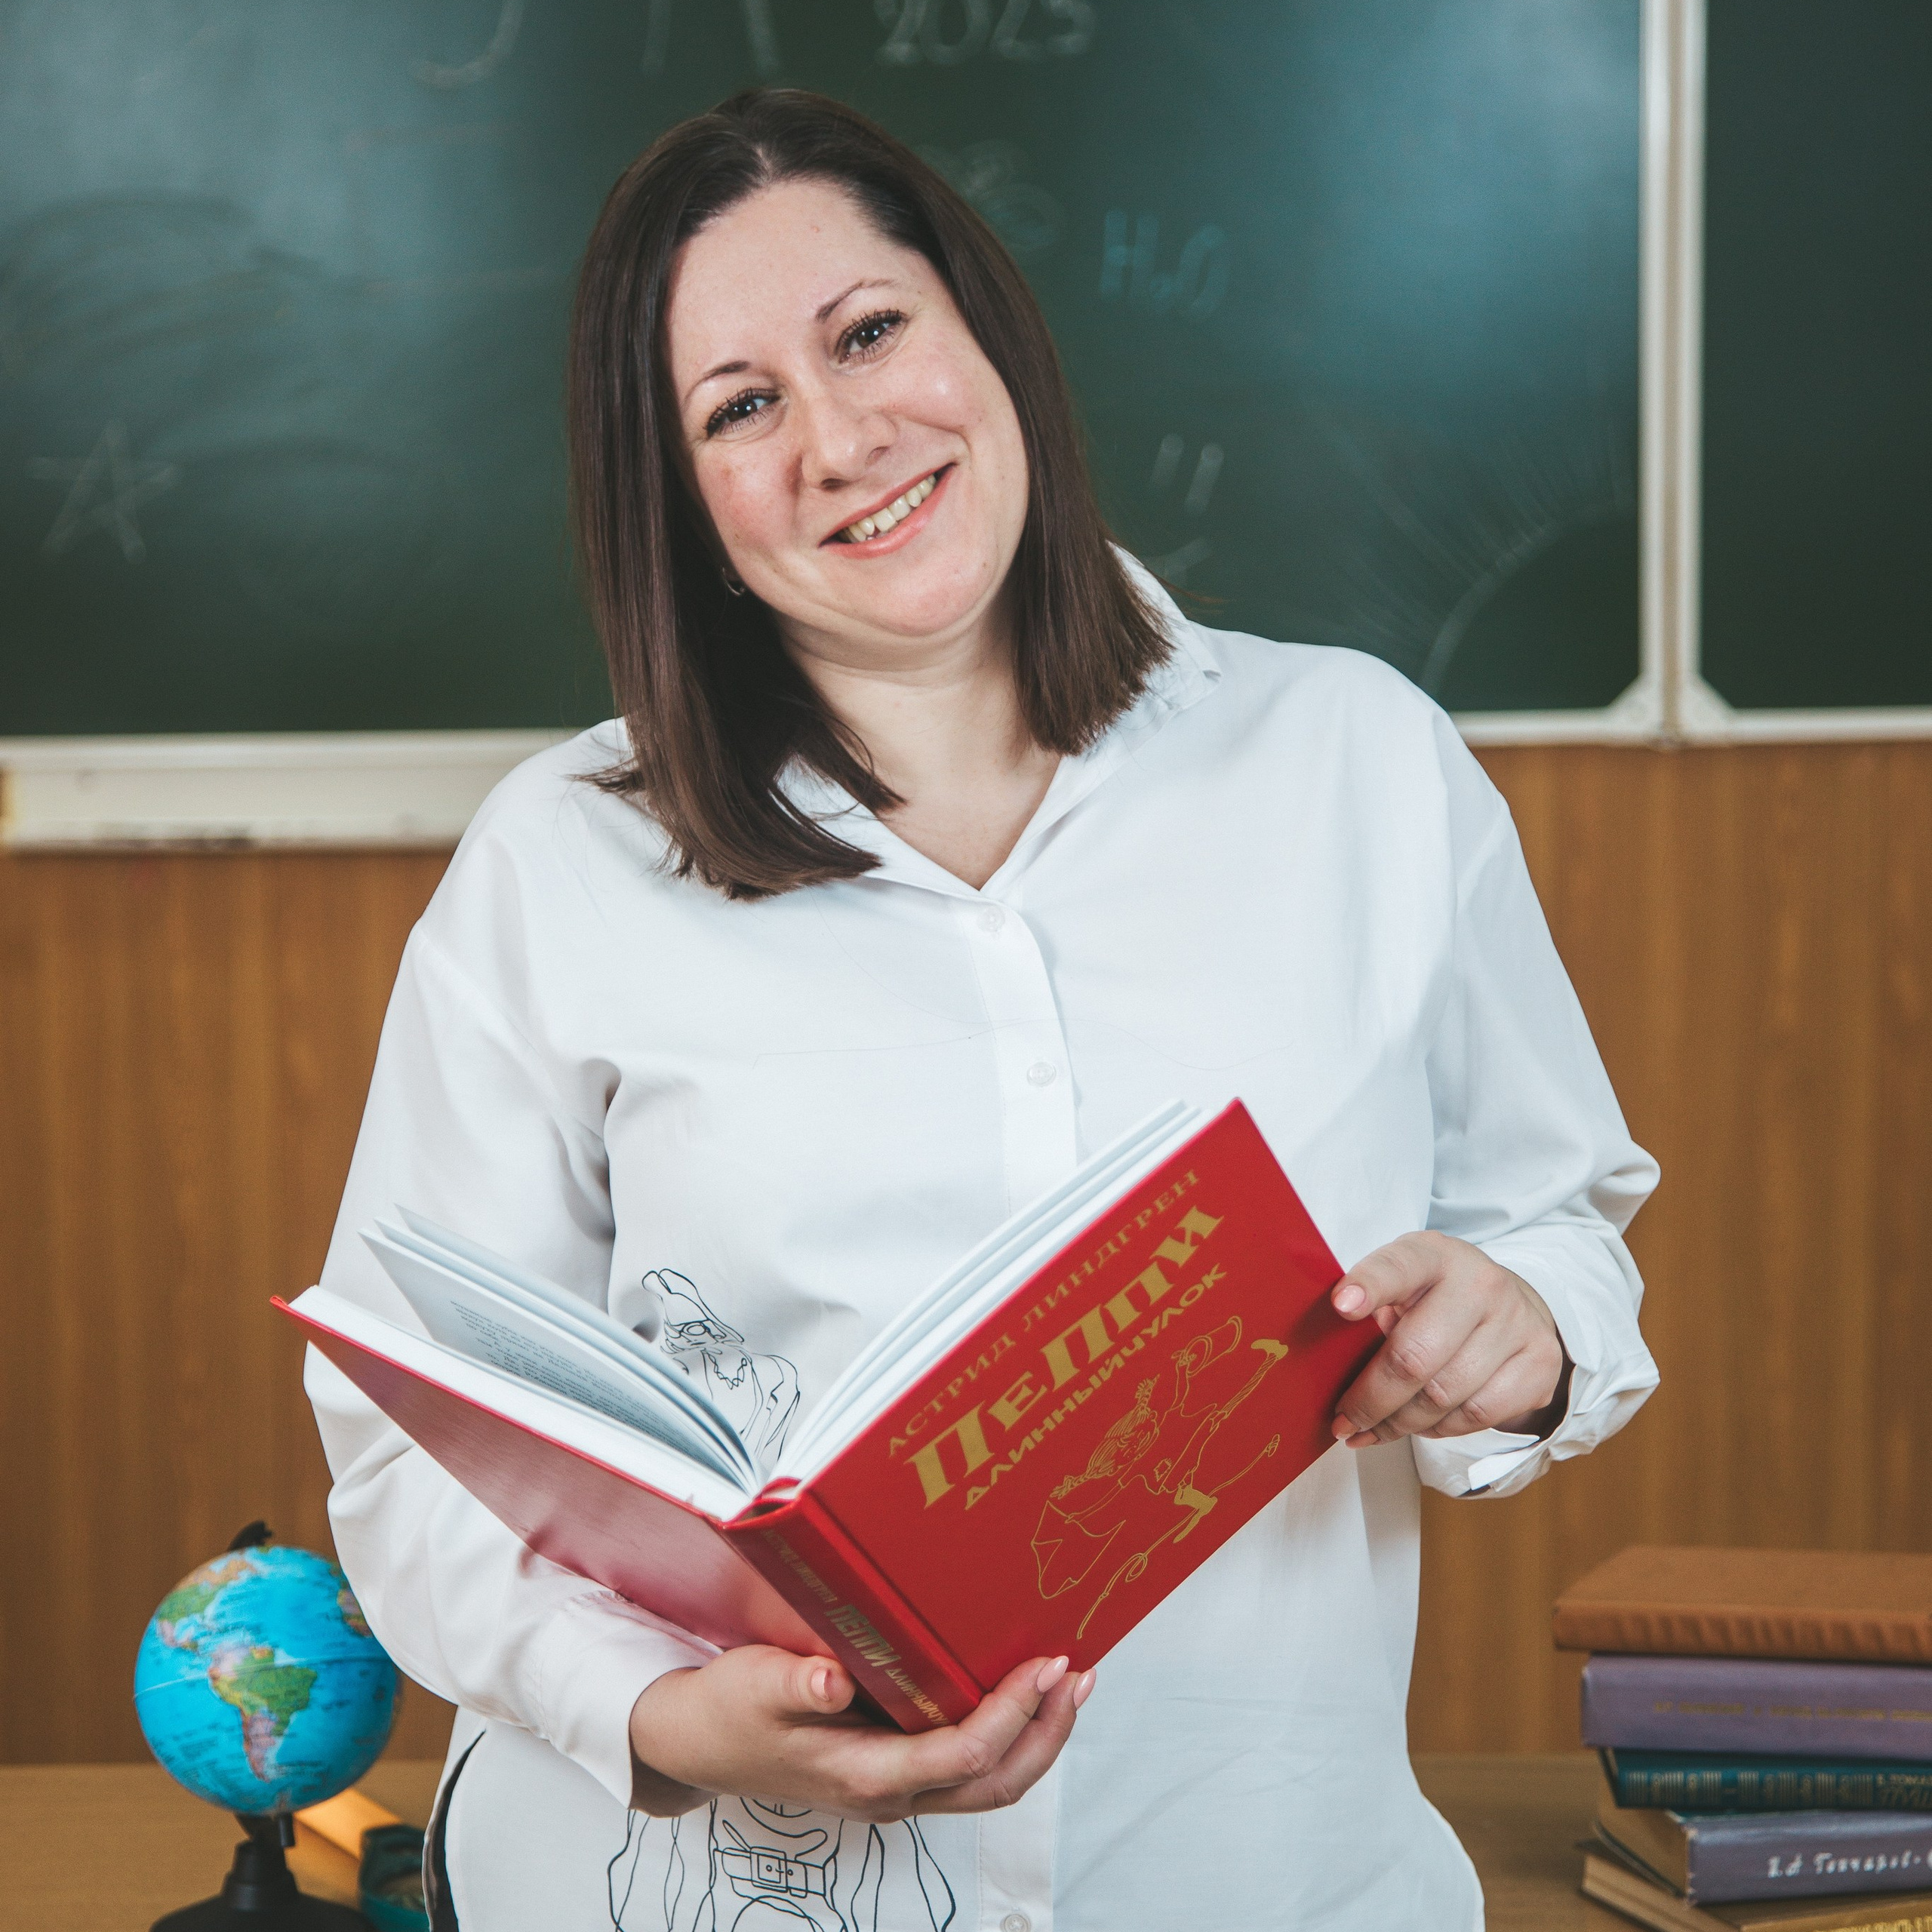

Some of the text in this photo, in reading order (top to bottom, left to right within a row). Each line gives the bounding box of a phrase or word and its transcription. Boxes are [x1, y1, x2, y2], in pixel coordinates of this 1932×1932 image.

[887, 1335, 1017, 1458] АСТРИД
[1021, 1169, 1199, 1335] ЛИНДГРЕН
[903, 1205, 1225, 1509] ПЕППИ
[823, 1604, 902, 1667] ПЕППИ
